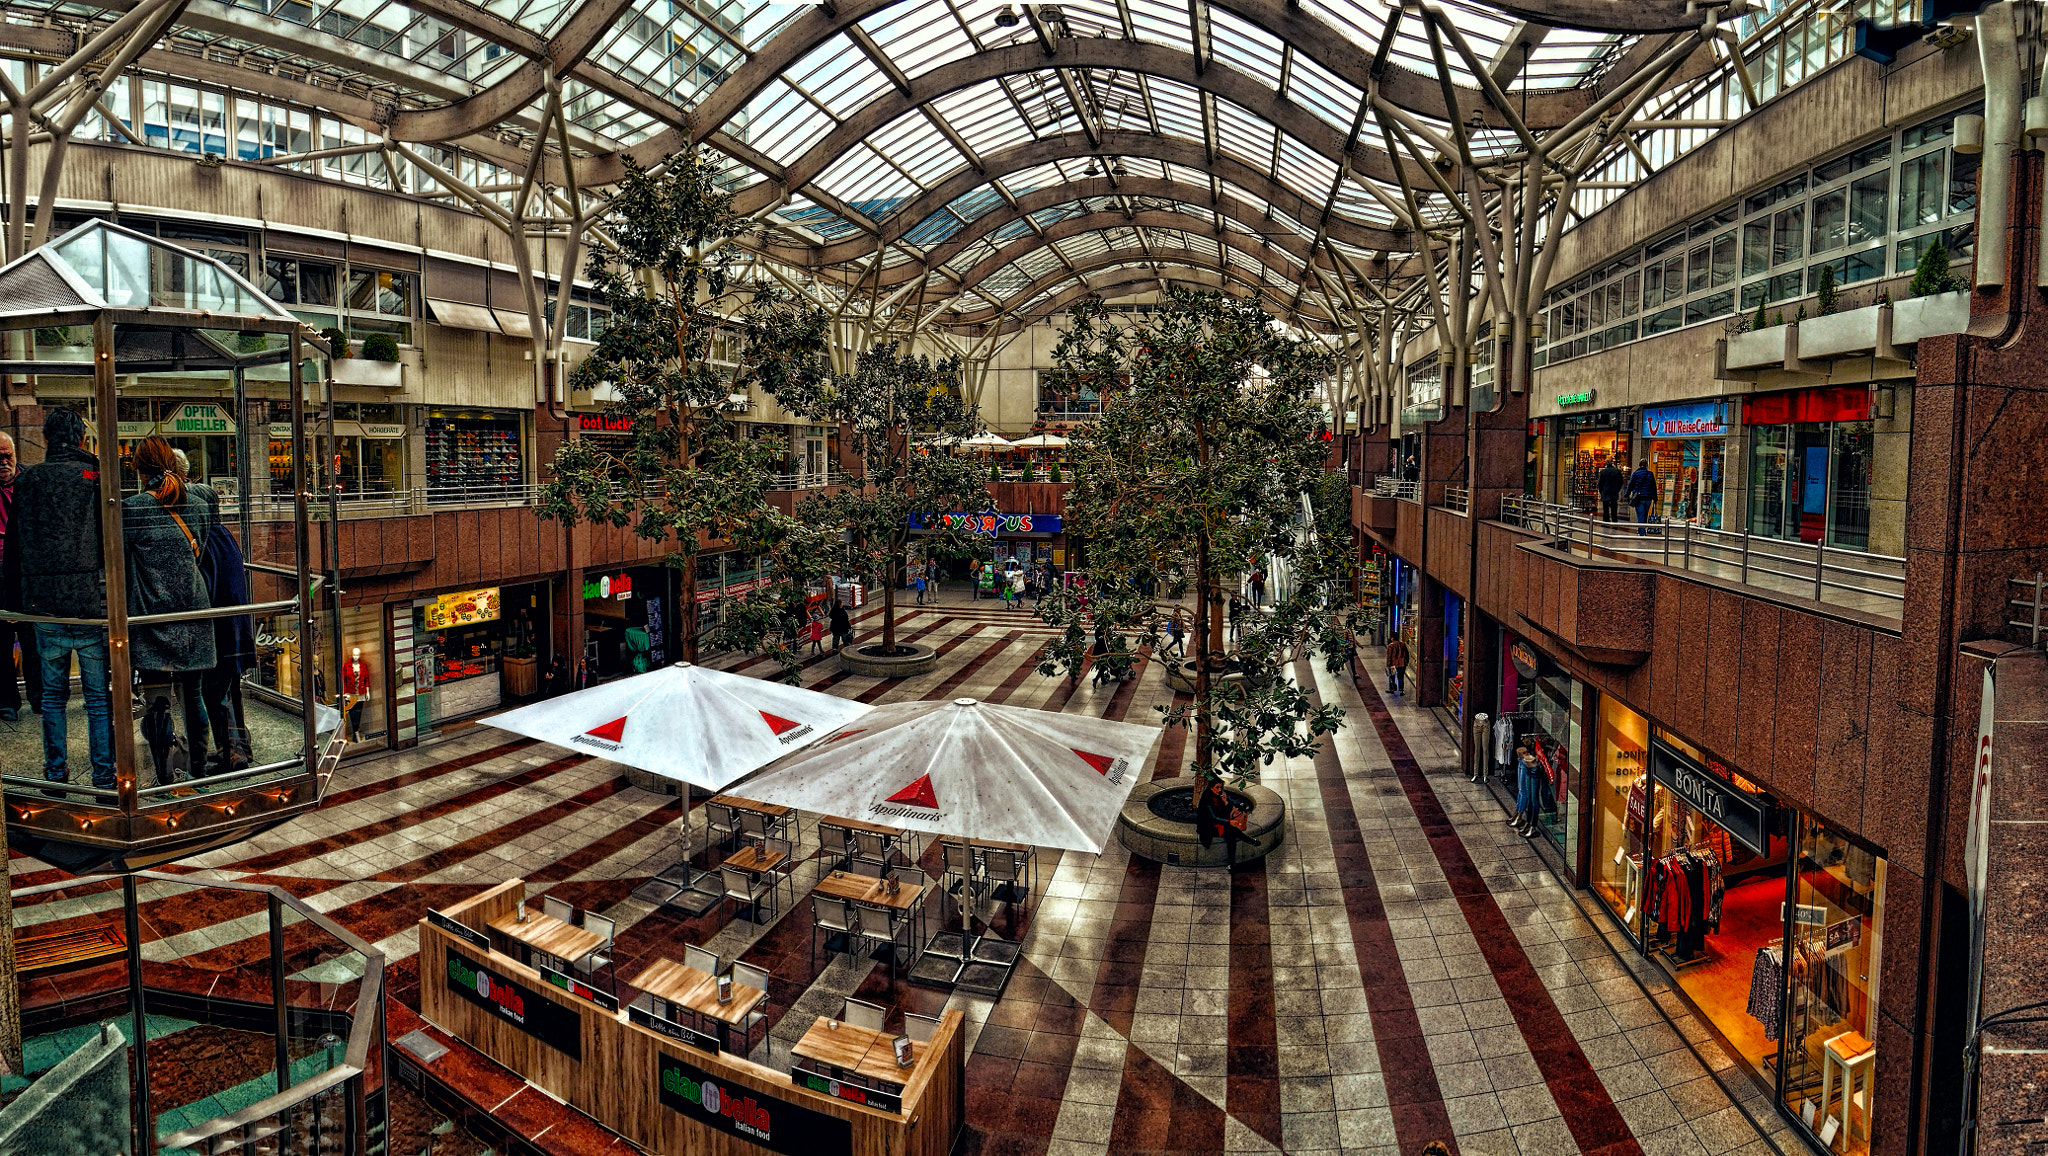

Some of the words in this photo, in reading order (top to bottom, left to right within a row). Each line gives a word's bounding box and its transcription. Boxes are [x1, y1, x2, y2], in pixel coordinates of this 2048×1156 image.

[184, 406, 217, 418] OPTIK
[176, 419, 227, 431] MUELLER
[1664, 420, 1676, 434] TUI
[1005, 515, 1034, 532] US
[609, 573, 632, 595] bella
[869, 802, 943, 822] Apollinaris
[1630, 796, 1645, 819] SALE
[449, 958, 477, 991] ciao
[488, 976, 524, 1017] bella
[663, 1067, 702, 1104] ciao
[719, 1087, 770, 1132] bella
[735, 1120, 755, 1136] italian
[756, 1126, 770, 1141] food
